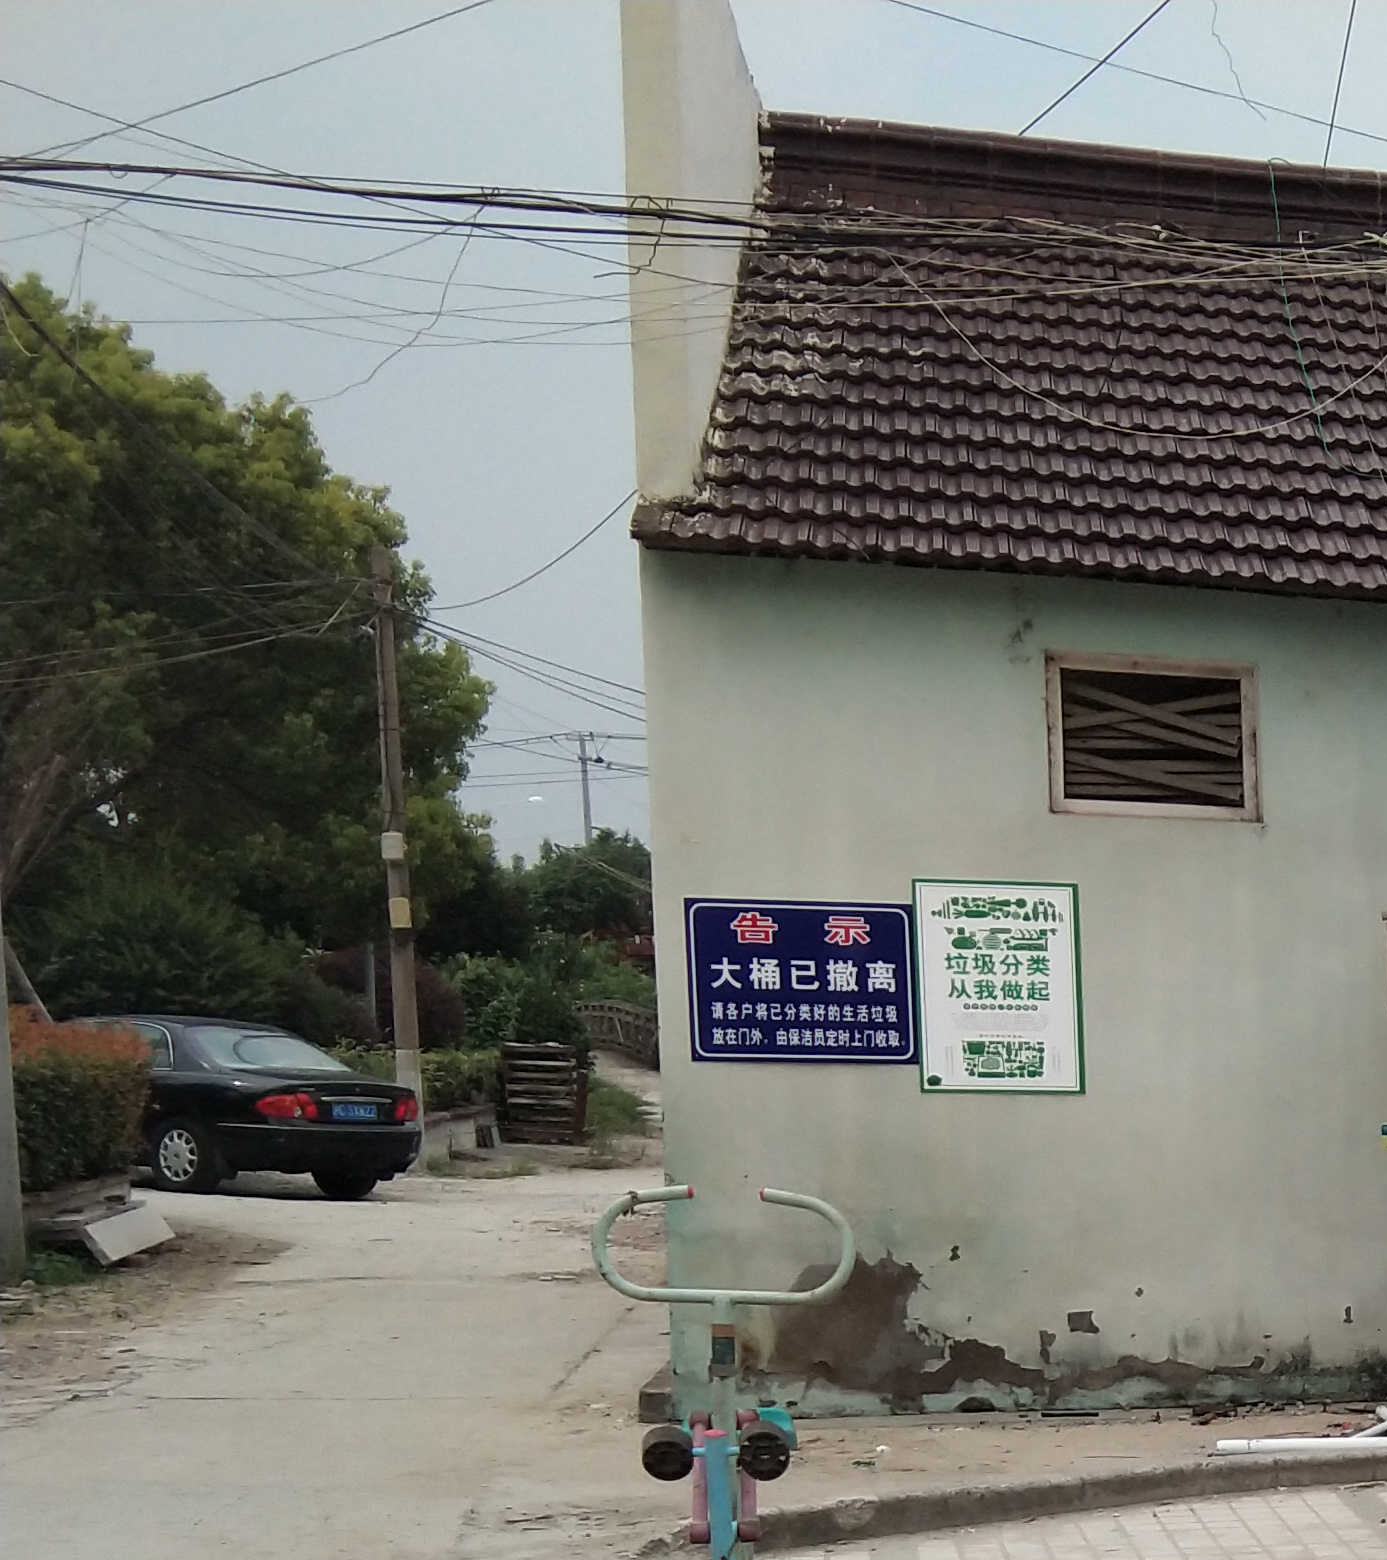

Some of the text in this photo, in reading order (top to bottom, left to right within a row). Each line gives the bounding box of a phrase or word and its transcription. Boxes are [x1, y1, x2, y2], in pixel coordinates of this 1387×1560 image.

[730, 911, 871, 947] 告示
[710, 956, 897, 993] 大桶已撤离
[944, 953, 1051, 977] 垃圾分类
[947, 978, 1051, 1002] 从我做起
[710, 1001, 899, 1023] 请各户将已分类好的生活垃圾
